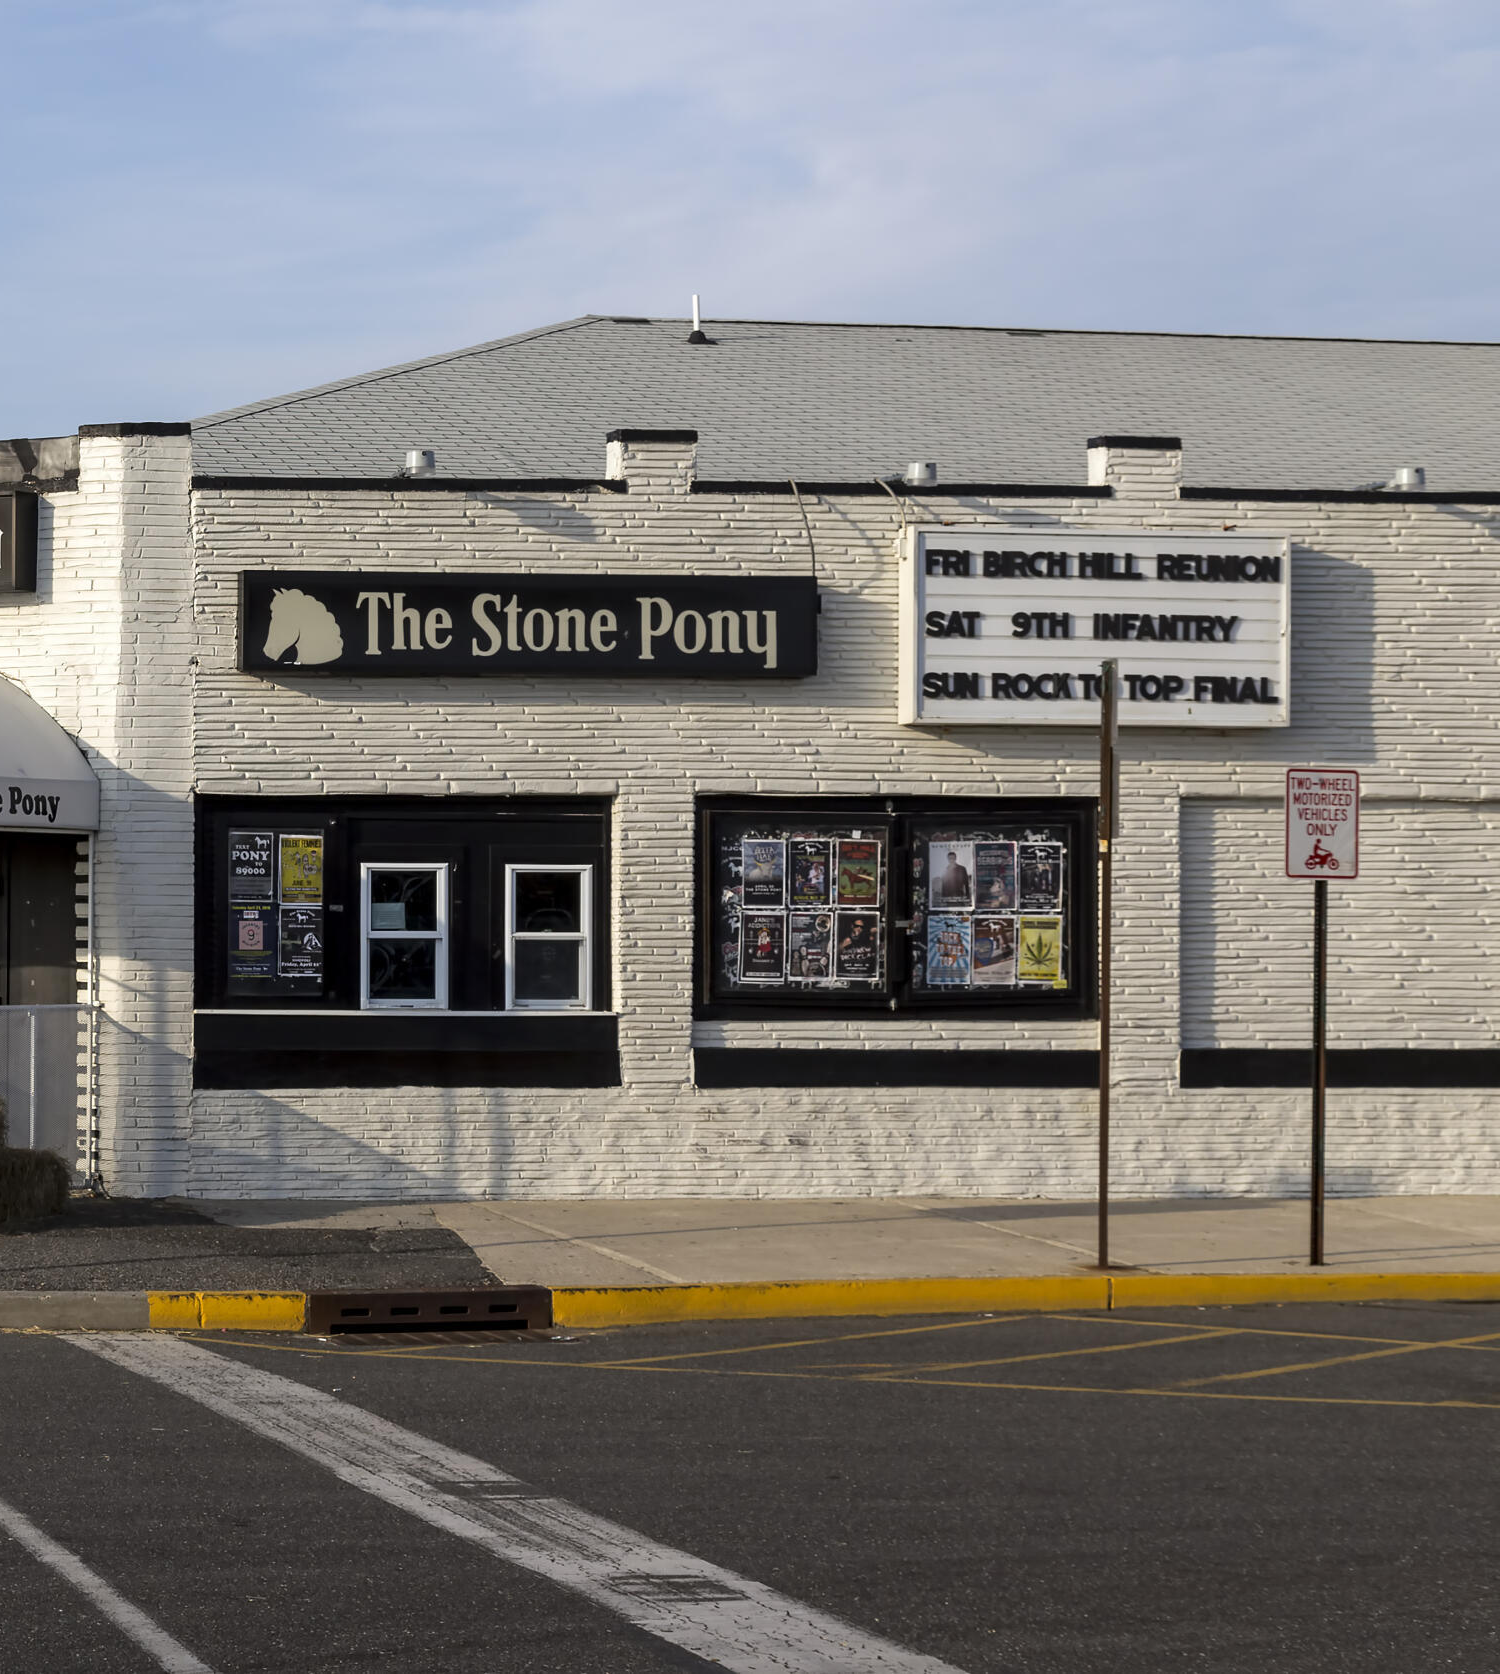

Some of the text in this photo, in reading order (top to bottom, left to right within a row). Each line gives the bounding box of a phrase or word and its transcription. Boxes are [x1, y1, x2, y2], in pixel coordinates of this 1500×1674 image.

[925, 549, 1281, 583] FRI BIRCH HILL REUNION
[355, 591, 778, 669] The Stone Pony
[925, 610, 1238, 642] SAT 9TH INFANTRY
[922, 671, 979, 700] SUN
[991, 672, 1071, 700] ROCK
[1124, 674, 1184, 701] TOP
[1194, 675, 1280, 704] FINAL
[1290, 776, 1355, 791] TWO-WHEEL
[8, 786, 61, 823] Pony
[1293, 792, 1352, 806] MOTORIZED
[1297, 807, 1348, 821] VEHICLES
[1306, 823, 1338, 836] ONLY
[232, 851, 270, 861] PONY
[235, 867, 266, 876] 89000
